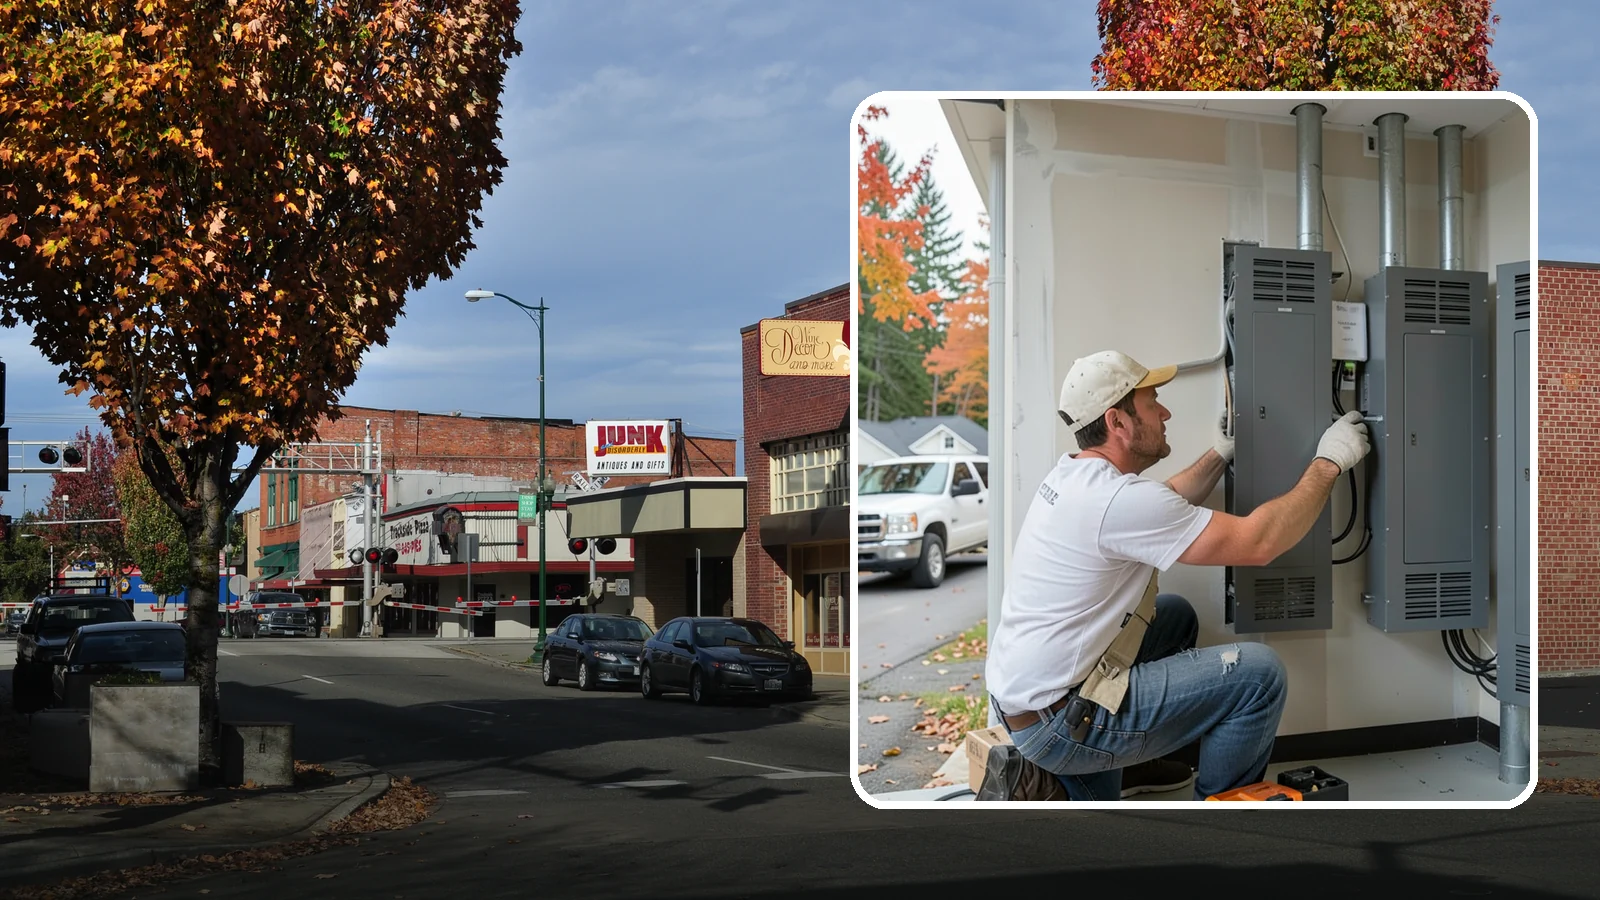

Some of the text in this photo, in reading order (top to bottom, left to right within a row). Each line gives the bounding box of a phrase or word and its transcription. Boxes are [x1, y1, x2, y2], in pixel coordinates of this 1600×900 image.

[791, 325, 824, 347] Wine
[595, 425, 665, 457] JUNK
[607, 446, 646, 454] DISORDERLY
[597, 460, 665, 470] ANTIQUES AND GIFTS
[352, 498, 364, 511] CRO
[390, 519, 429, 540] Trackside Pizza
